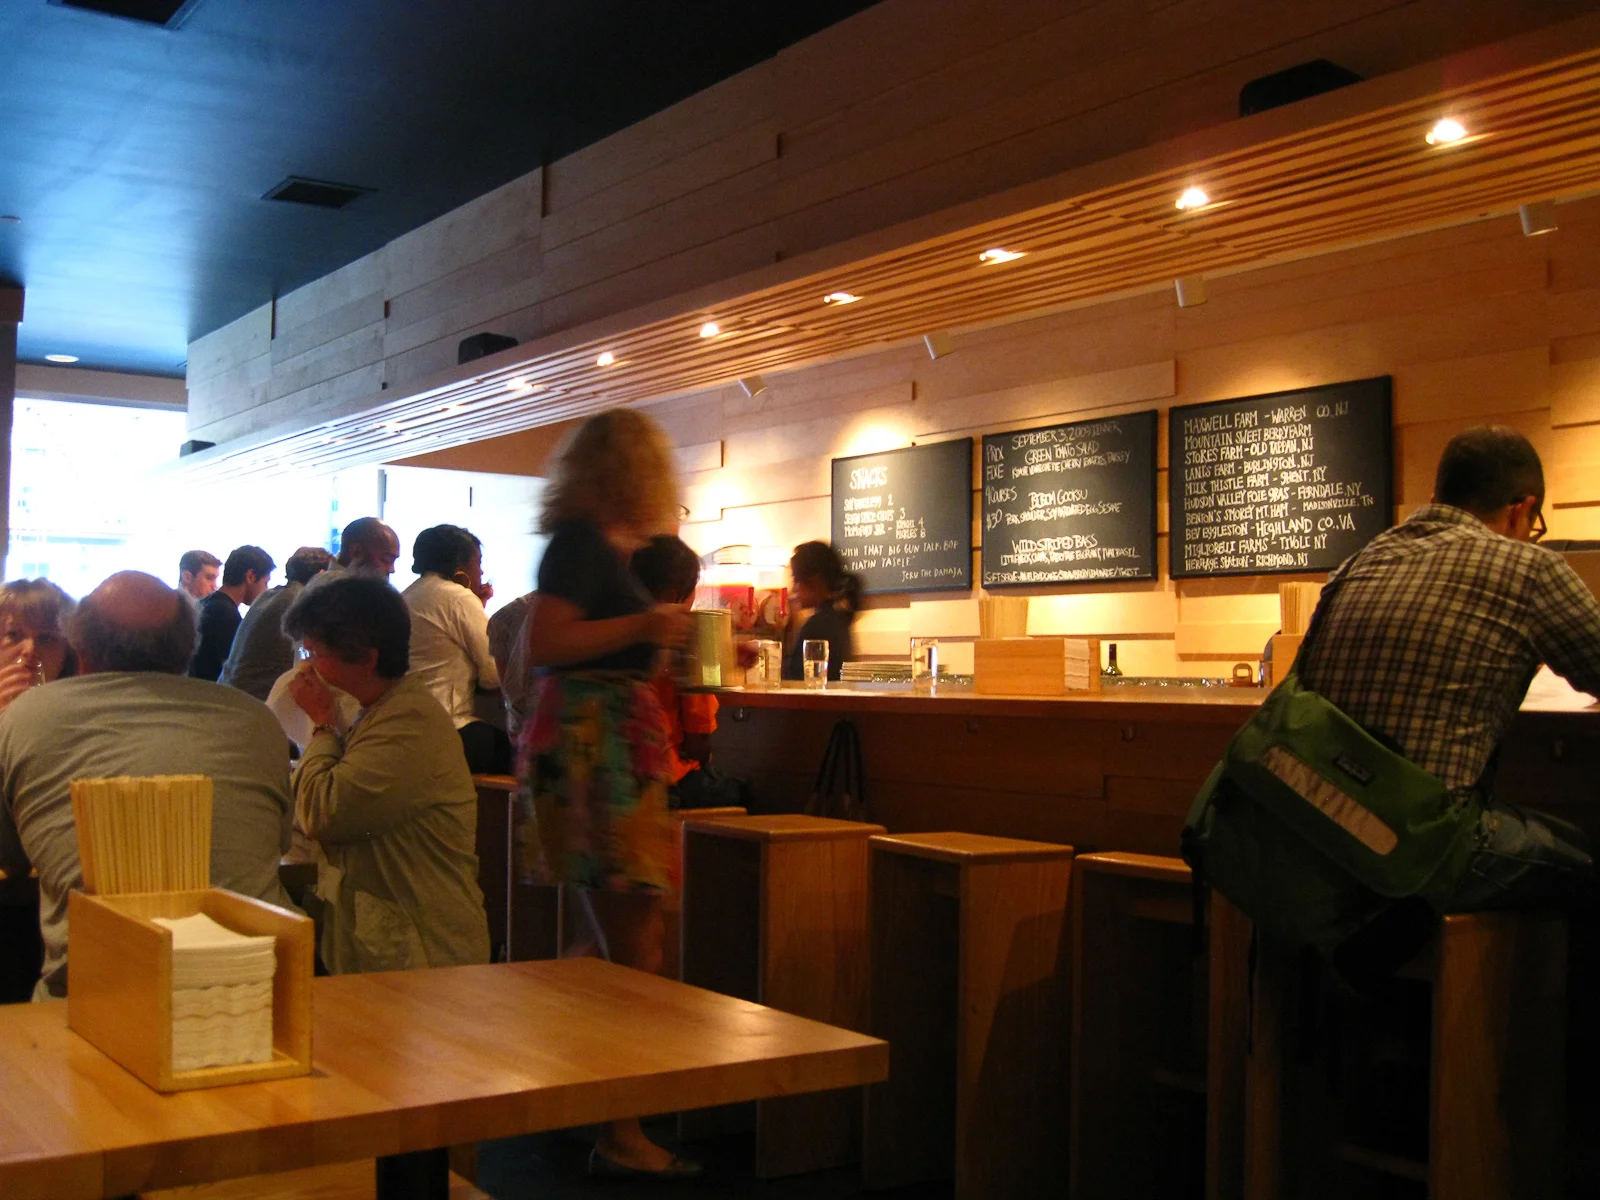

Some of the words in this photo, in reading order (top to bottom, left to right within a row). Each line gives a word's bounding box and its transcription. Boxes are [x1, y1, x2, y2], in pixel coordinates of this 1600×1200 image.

[1184, 414, 1232, 434] MAXWELL
[1234, 410, 1258, 428] FARM
[1271, 404, 1306, 424] WARREN
[1335, 400, 1349, 415] NJ
[1012, 430, 1057, 451] SEPTEMBER
[1184, 431, 1232, 450] MOUNTAIN
[1235, 428, 1262, 444] SWEET
[986, 444, 1004, 463] PRIX
[1024, 448, 1052, 465] GREEN
[1053, 443, 1075, 459] TOMATO
[1077, 440, 1100, 457] SALAD
[1184, 448, 1219, 465] STOKES
[1220, 444, 1244, 461] FARM
[1250, 442, 1268, 456] OLD
[1301, 437, 1314, 451] NJ
[986, 463, 1004, 481] FIXE
[1214, 461, 1235, 476] FARM
[1301, 453, 1315, 468] NJ
[850, 466, 888, 490] SNACKS
[1185, 480, 1208, 496] MILK
[1210, 475, 1244, 492] THISTLE
[1247, 472, 1269, 488] FARM
[1312, 466, 1327, 482] NY
[887, 493, 894, 506] 2
[1057, 488, 1088, 506] GOOKSU
[1184, 494, 1214, 510] HUDSON
[1216, 489, 1247, 506] VALLEY
[1247, 489, 1268, 503] FOIE
[1268, 486, 1290, 502] GRAS
[1346, 481, 1362, 497] NY
[899, 507, 906, 520] 3
[1223, 503, 1254, 521] SMOKEY
[1270, 502, 1289, 517] HAM
[1360, 494, 1374, 507] TN
[844, 524, 873, 538] MOMOFUKU
[918, 517, 924, 528] 4
[986, 508, 1003, 531] $30
[1185, 527, 1201, 541] BEV
[1202, 521, 1249, 540] EGGLESTON
[1255, 515, 1312, 541] HIGHLAND
[1339, 512, 1356, 531] VA
[896, 528, 918, 540] PICKLES
[1012, 540, 1037, 554] WILD
[1037, 536, 1073, 552] STRIPED
[1073, 533, 1098, 549] BASS
[864, 543, 883, 556] THAT
[888, 543, 901, 556] BIG
[903, 542, 920, 554] GUN
[1115, 546, 1140, 558] BASIL
[1184, 540, 1236, 559] MIGLIORELLI
[1238, 537, 1268, 555] FARMS
[1279, 534, 1311, 551] TIVOLI
[1314, 533, 1328, 549] NY
[1185, 555, 1219, 572] HERITAGE
[1220, 555, 1250, 569] STATION
[1297, 552, 1309, 567] NJ
[985, 570, 1000, 583] SOFT
